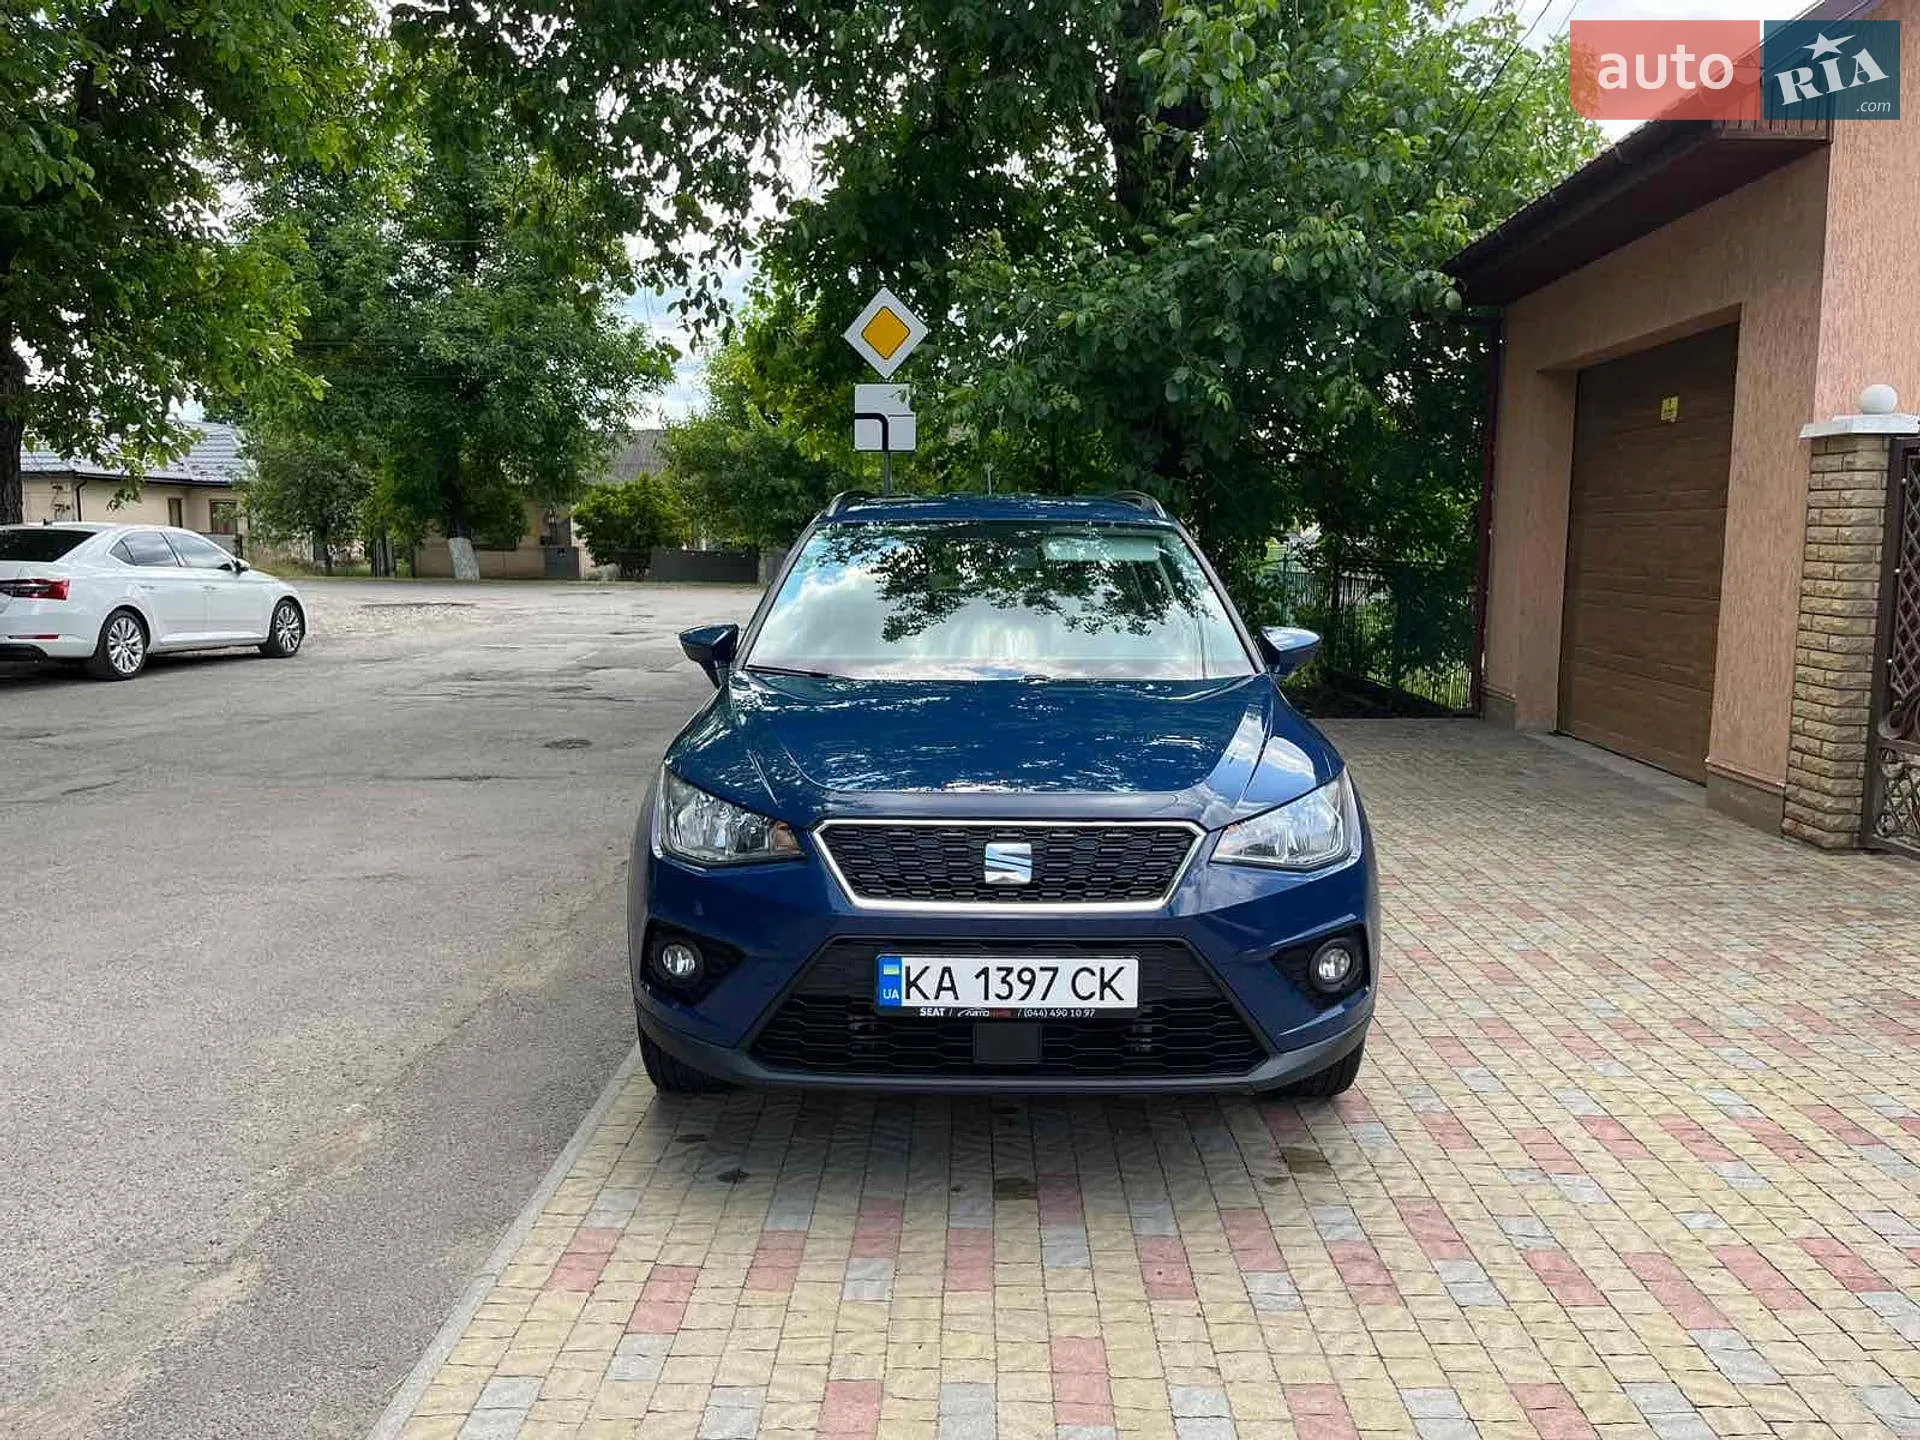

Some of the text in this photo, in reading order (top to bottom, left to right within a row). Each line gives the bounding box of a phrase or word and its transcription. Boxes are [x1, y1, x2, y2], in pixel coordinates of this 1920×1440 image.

[904, 965, 1125, 1001] KA 1397 CK
[883, 988, 900, 1000] UA
[920, 1007, 945, 1017] SEAT
[1049, 1007, 1068, 1018] 490
[1070, 1007, 1082, 1018] 10
[1083, 1007, 1096, 1018] 97
